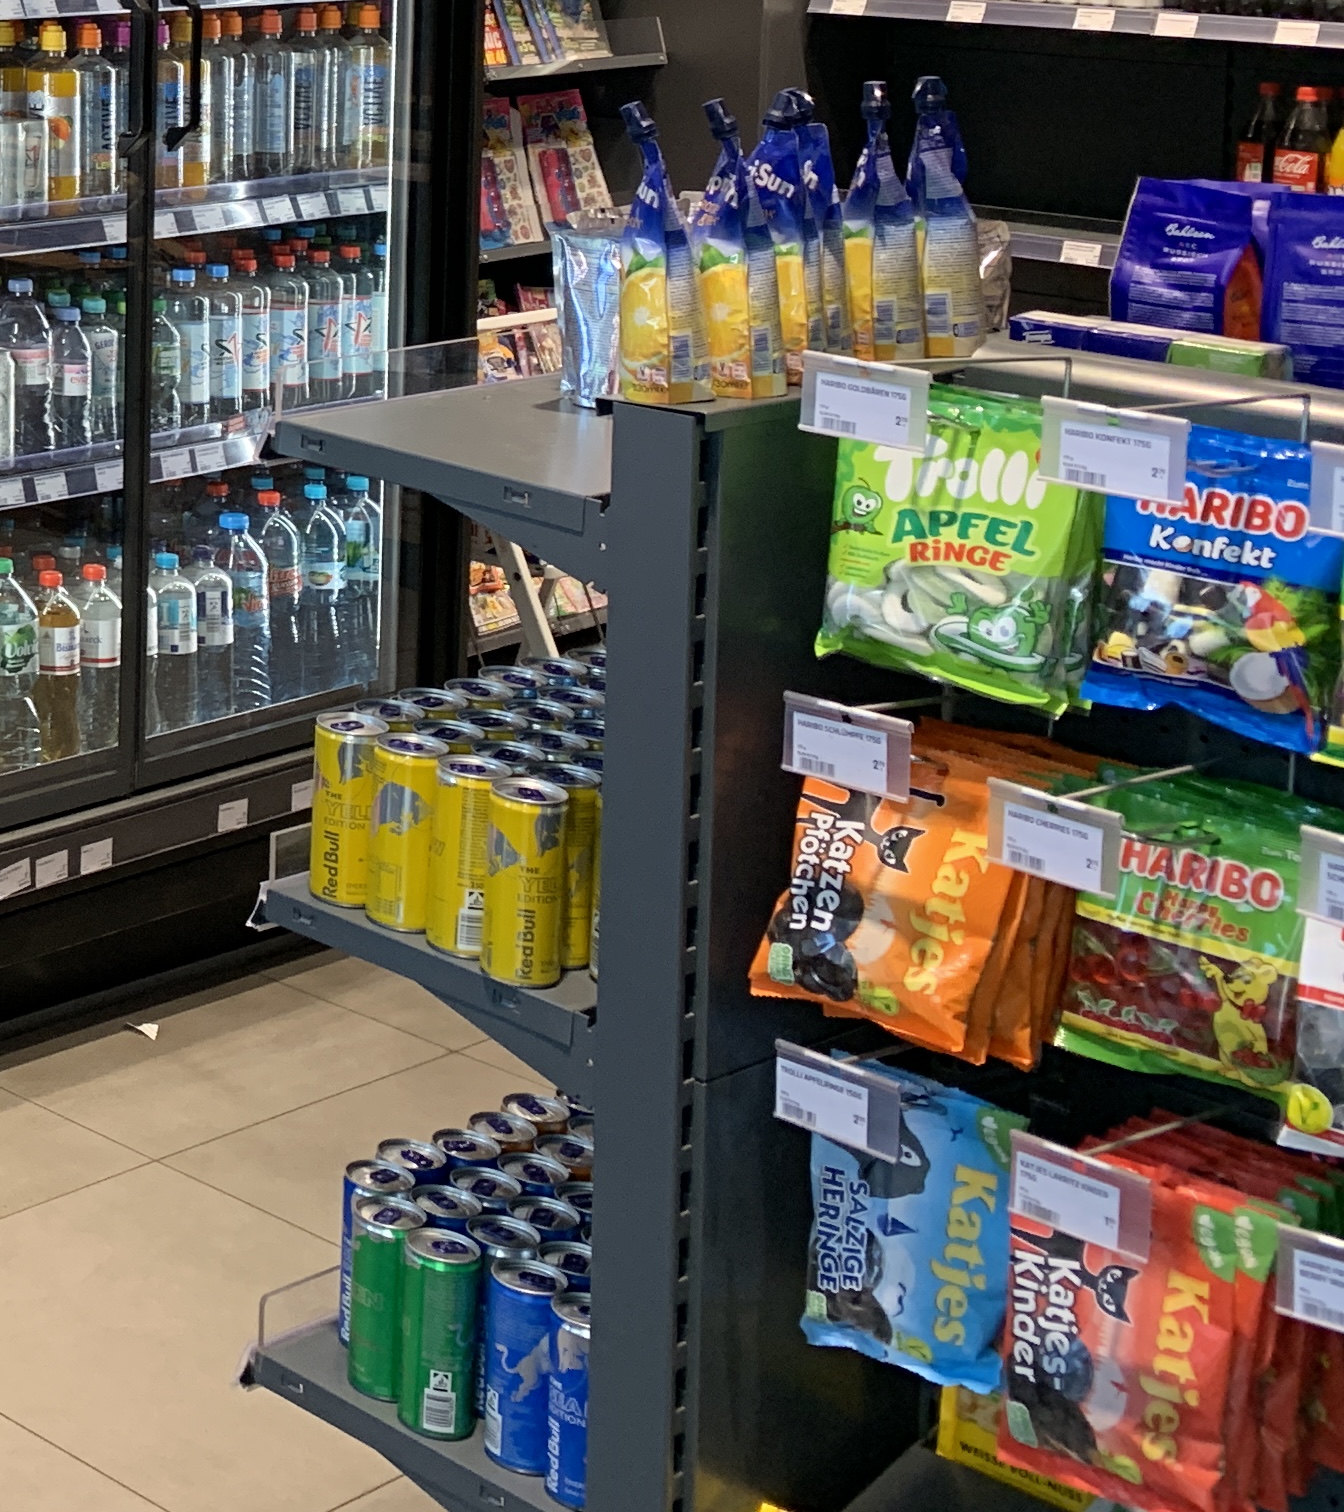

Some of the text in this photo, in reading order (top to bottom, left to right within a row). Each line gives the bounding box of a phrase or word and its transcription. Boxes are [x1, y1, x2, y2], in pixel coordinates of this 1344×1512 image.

[1165, 222, 1215, 240] Bahlsen
[820, 378, 845, 389] HARIBO
[1064, 428, 1093, 439] HARIBO
[1095, 433, 1131, 445] KONFEKT
[891, 507, 1039, 557] APFEL
[1149, 523, 1276, 569] Konfekt
[797, 718, 823, 731] HARIBO
[324, 791, 342, 800] THE
[324, 818, 366, 830] EDITION
[322, 831, 340, 898] Red Bull
[788, 810, 832, 930] Pfötchen
[810, 818, 866, 933] Katzen
[1120, 837, 1284, 911] HARIBO
[1136, 889, 1250, 945] Cherries
[781, 1065, 803, 1078] TROLLI
[817, 1165, 846, 1293] HERINGE
[841, 1179, 870, 1292] SALZIGE
[930, 1163, 998, 1347] Katjes
[1010, 1248, 1048, 1383] Kinder
[1137, 1268, 1210, 1464] Katjes
